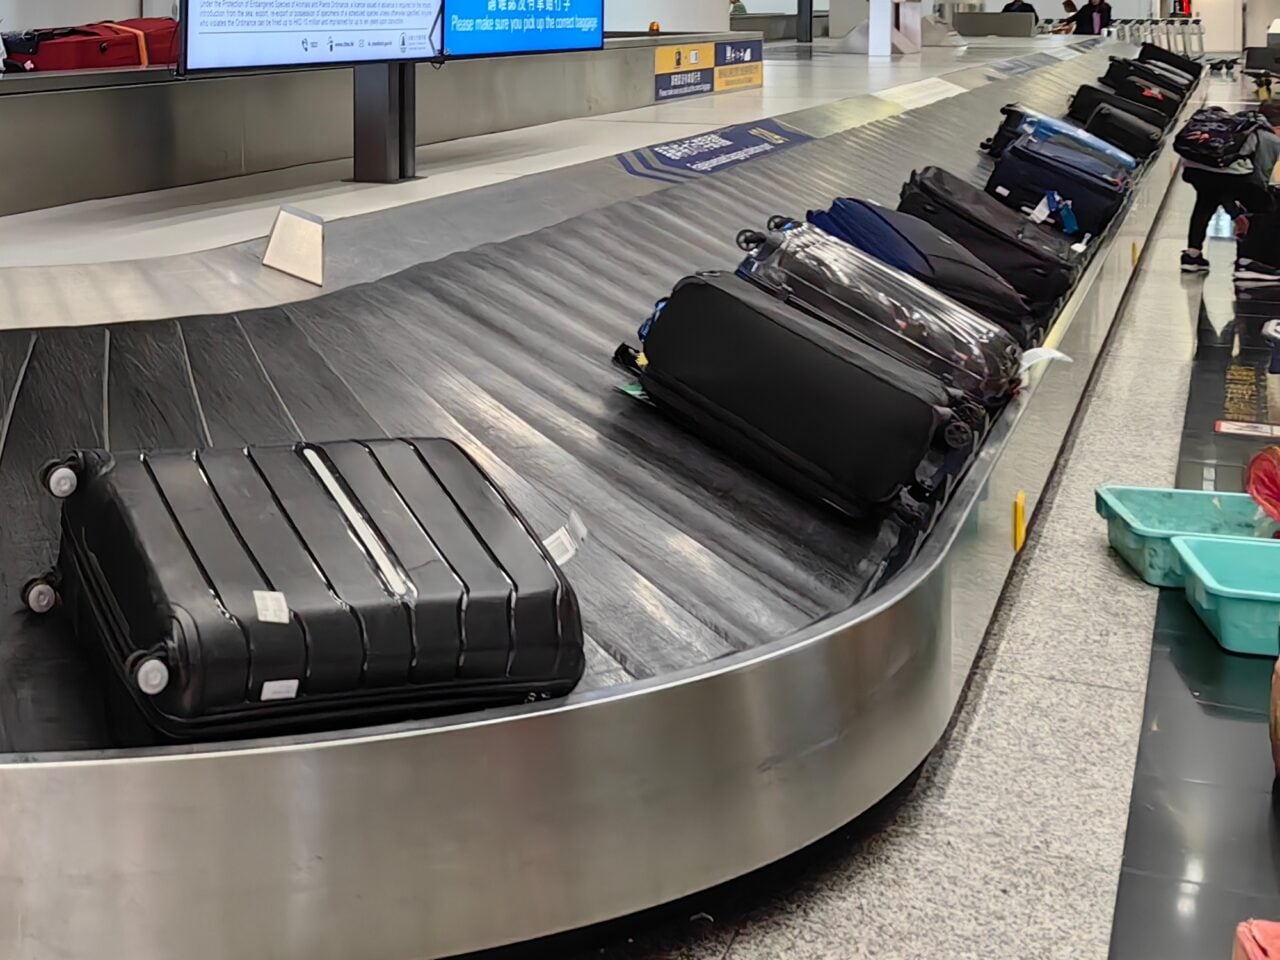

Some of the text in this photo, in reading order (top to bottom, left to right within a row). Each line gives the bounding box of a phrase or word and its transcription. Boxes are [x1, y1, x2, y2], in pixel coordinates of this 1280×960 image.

[451, 15, 473, 31] Please
[475, 16, 494, 31] make
[495, 19, 509, 30] sure
[510, 18, 522, 32] you
[523, 14, 535, 32] pick
[536, 18, 545, 32] up
[545, 15, 555, 29] the
[556, 16, 575, 29] correct
